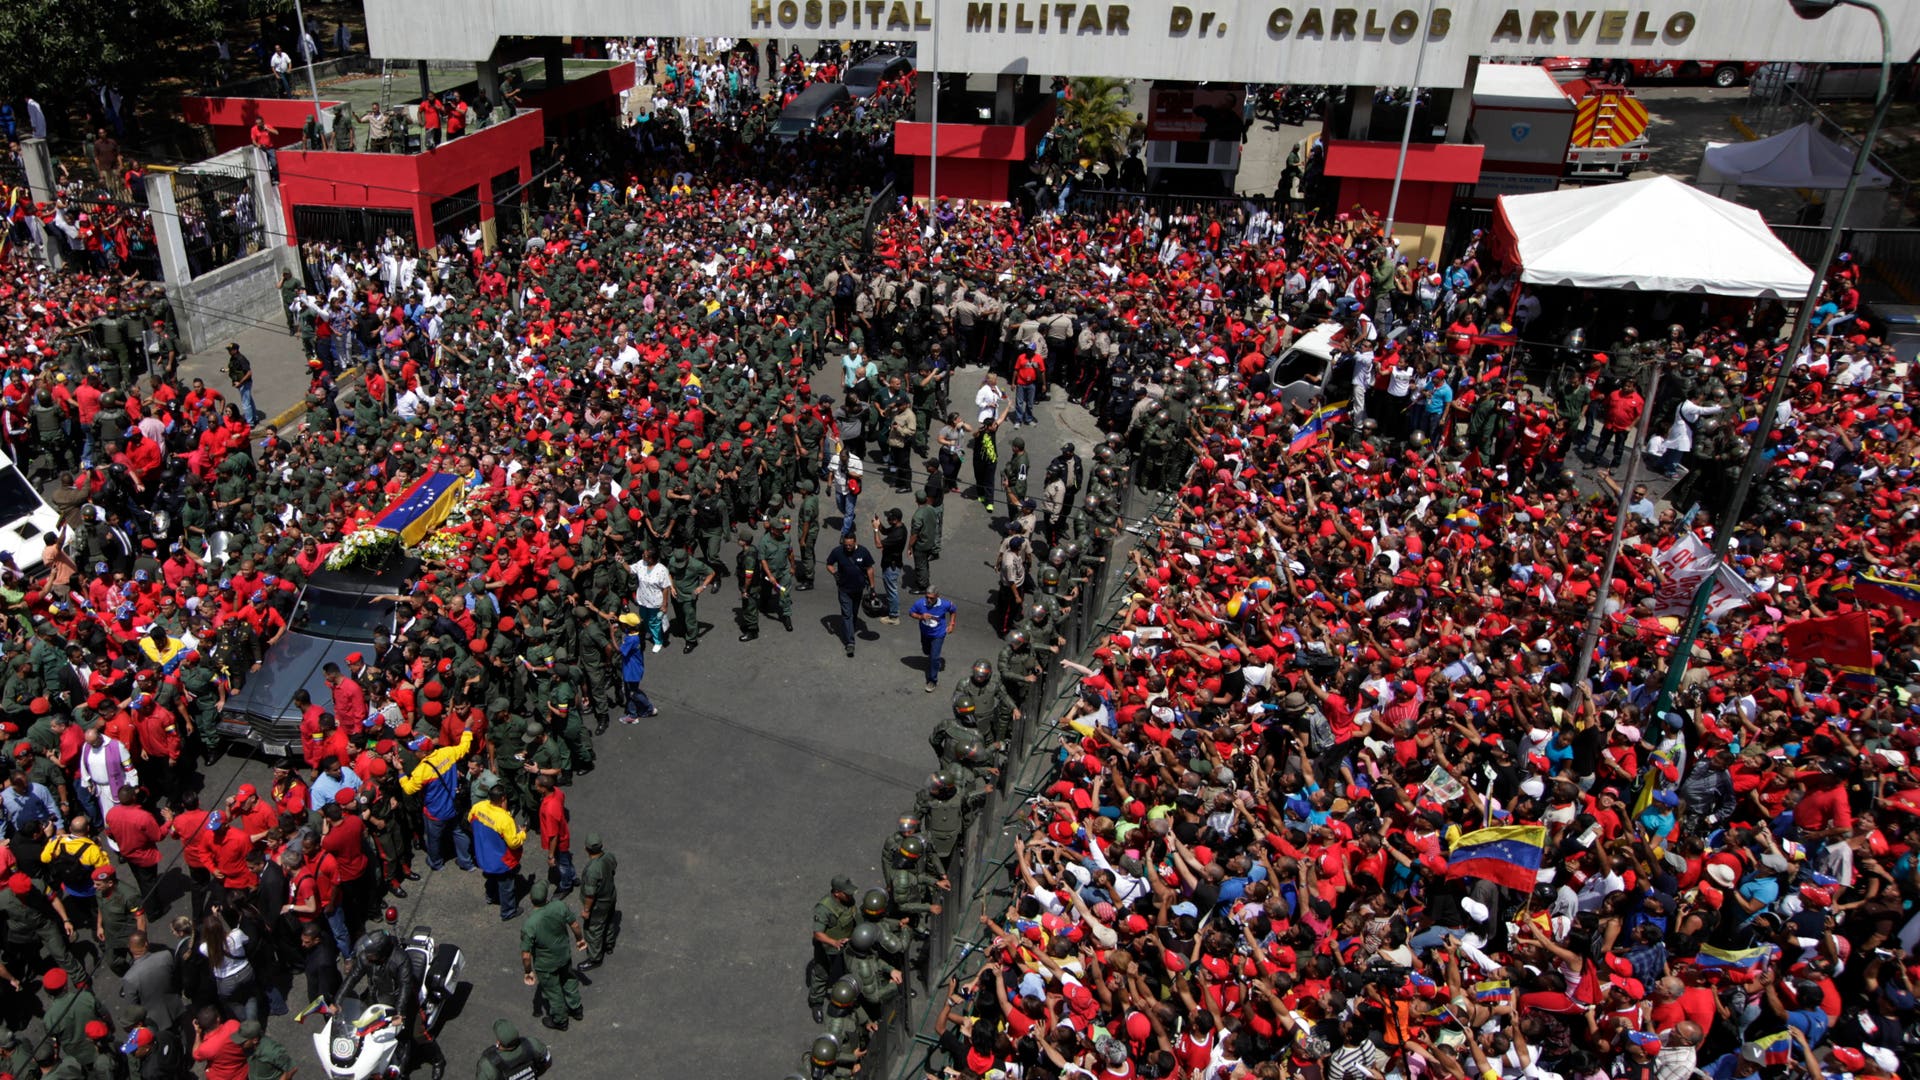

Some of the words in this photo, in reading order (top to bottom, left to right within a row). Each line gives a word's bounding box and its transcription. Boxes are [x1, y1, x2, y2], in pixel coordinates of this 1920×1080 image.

[751, 0, 932, 30] HOSPITAL
[967, 2, 1129, 34] MILITAR
[1169, 6, 1228, 37] Dr.
[1266, 8, 1452, 43] CARLOS
[1491, 9, 1696, 44] ARVELO
